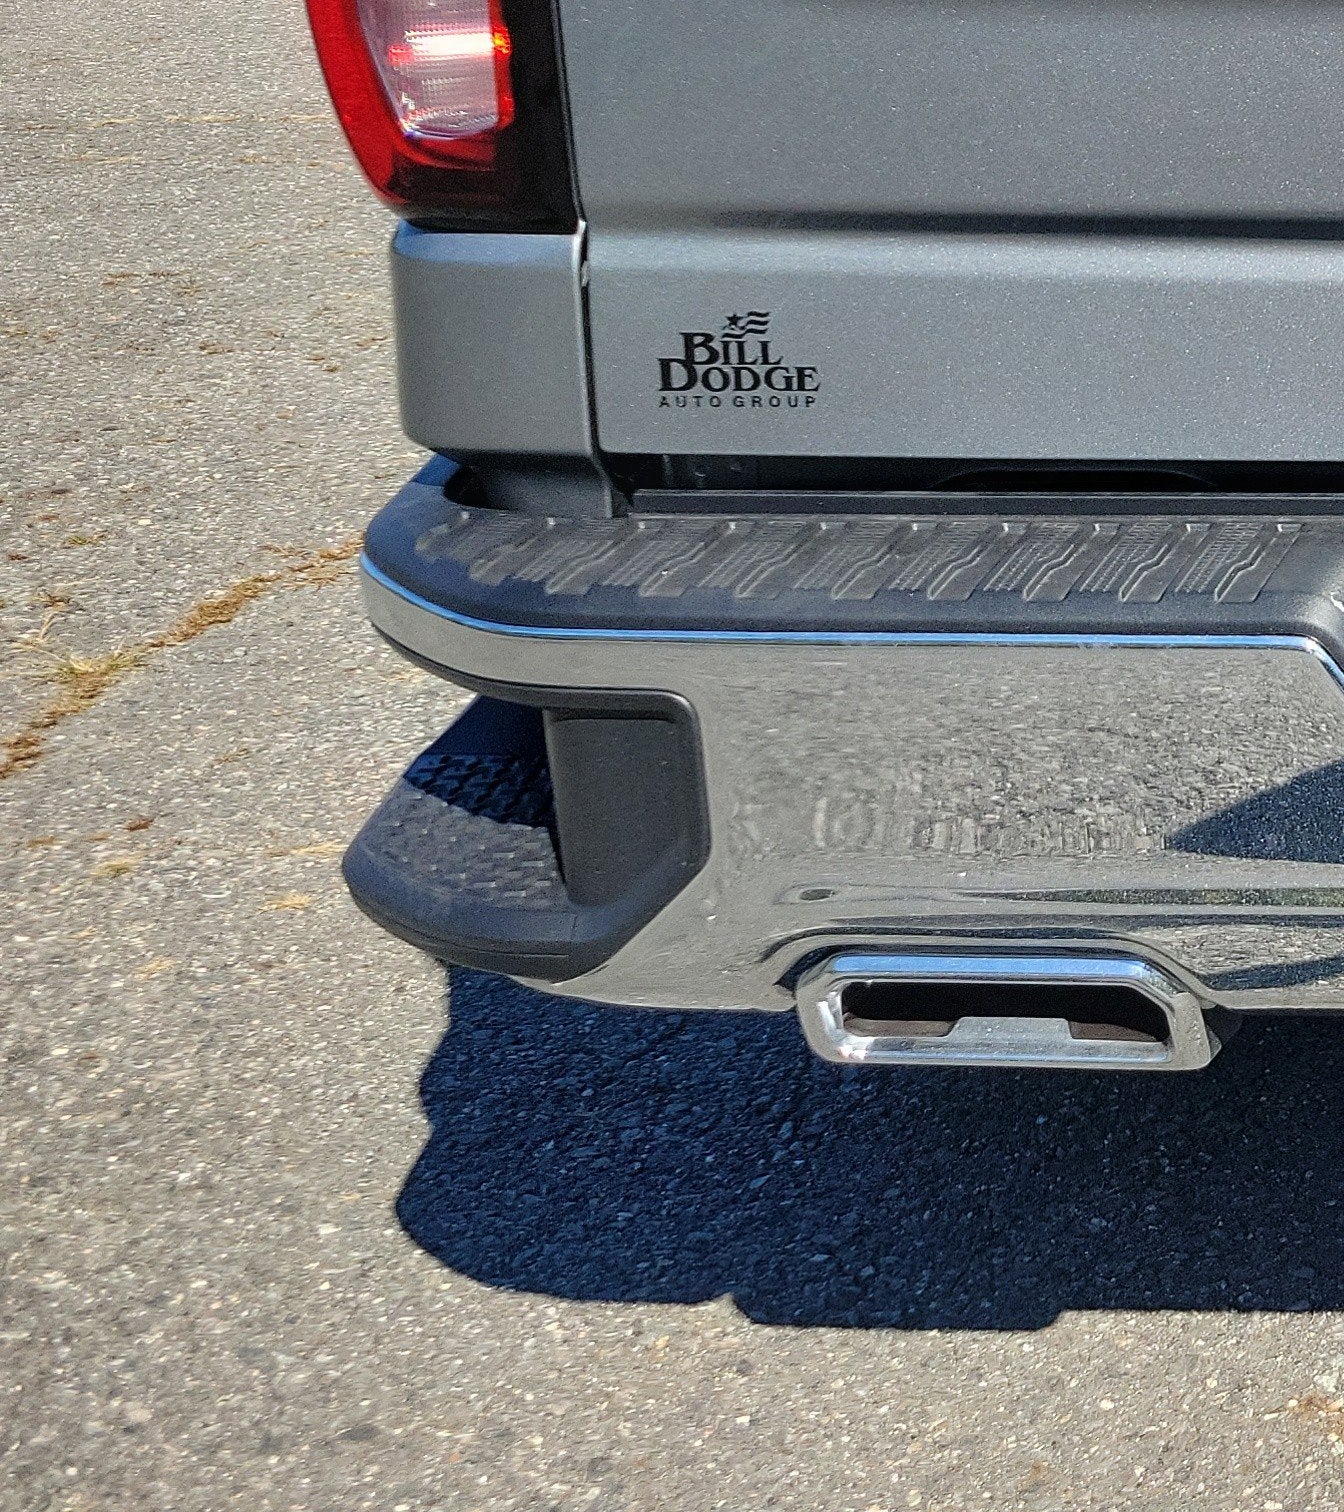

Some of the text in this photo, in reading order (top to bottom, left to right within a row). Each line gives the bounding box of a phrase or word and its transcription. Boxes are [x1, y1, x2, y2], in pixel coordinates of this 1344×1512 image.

[679, 332, 784, 366] BILL
[656, 357, 821, 392] DODGE
[658, 395, 817, 408] AUTO GROUP
